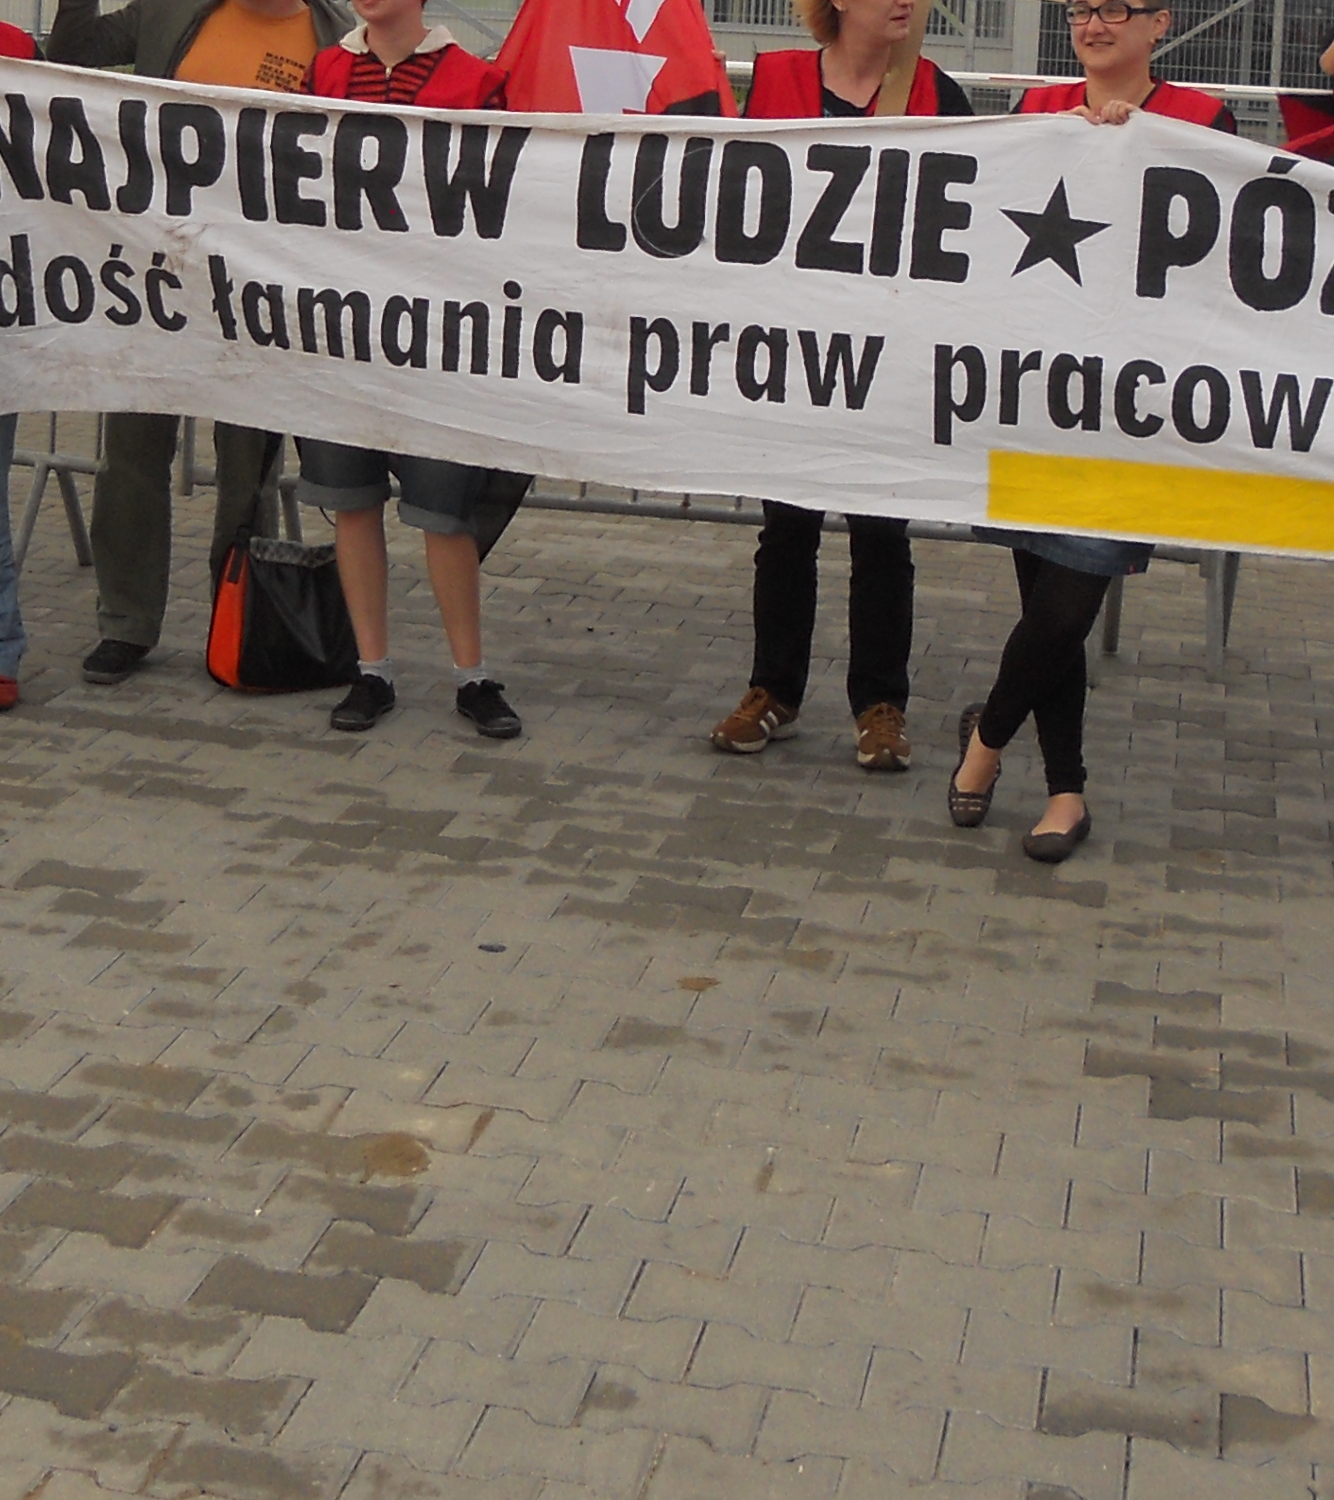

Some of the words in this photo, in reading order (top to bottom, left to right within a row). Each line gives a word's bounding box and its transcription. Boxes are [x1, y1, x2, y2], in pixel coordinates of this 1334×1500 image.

[575, 131, 979, 284] LUDZIE
[207, 254, 584, 385] łamania
[625, 315, 886, 416] praw
